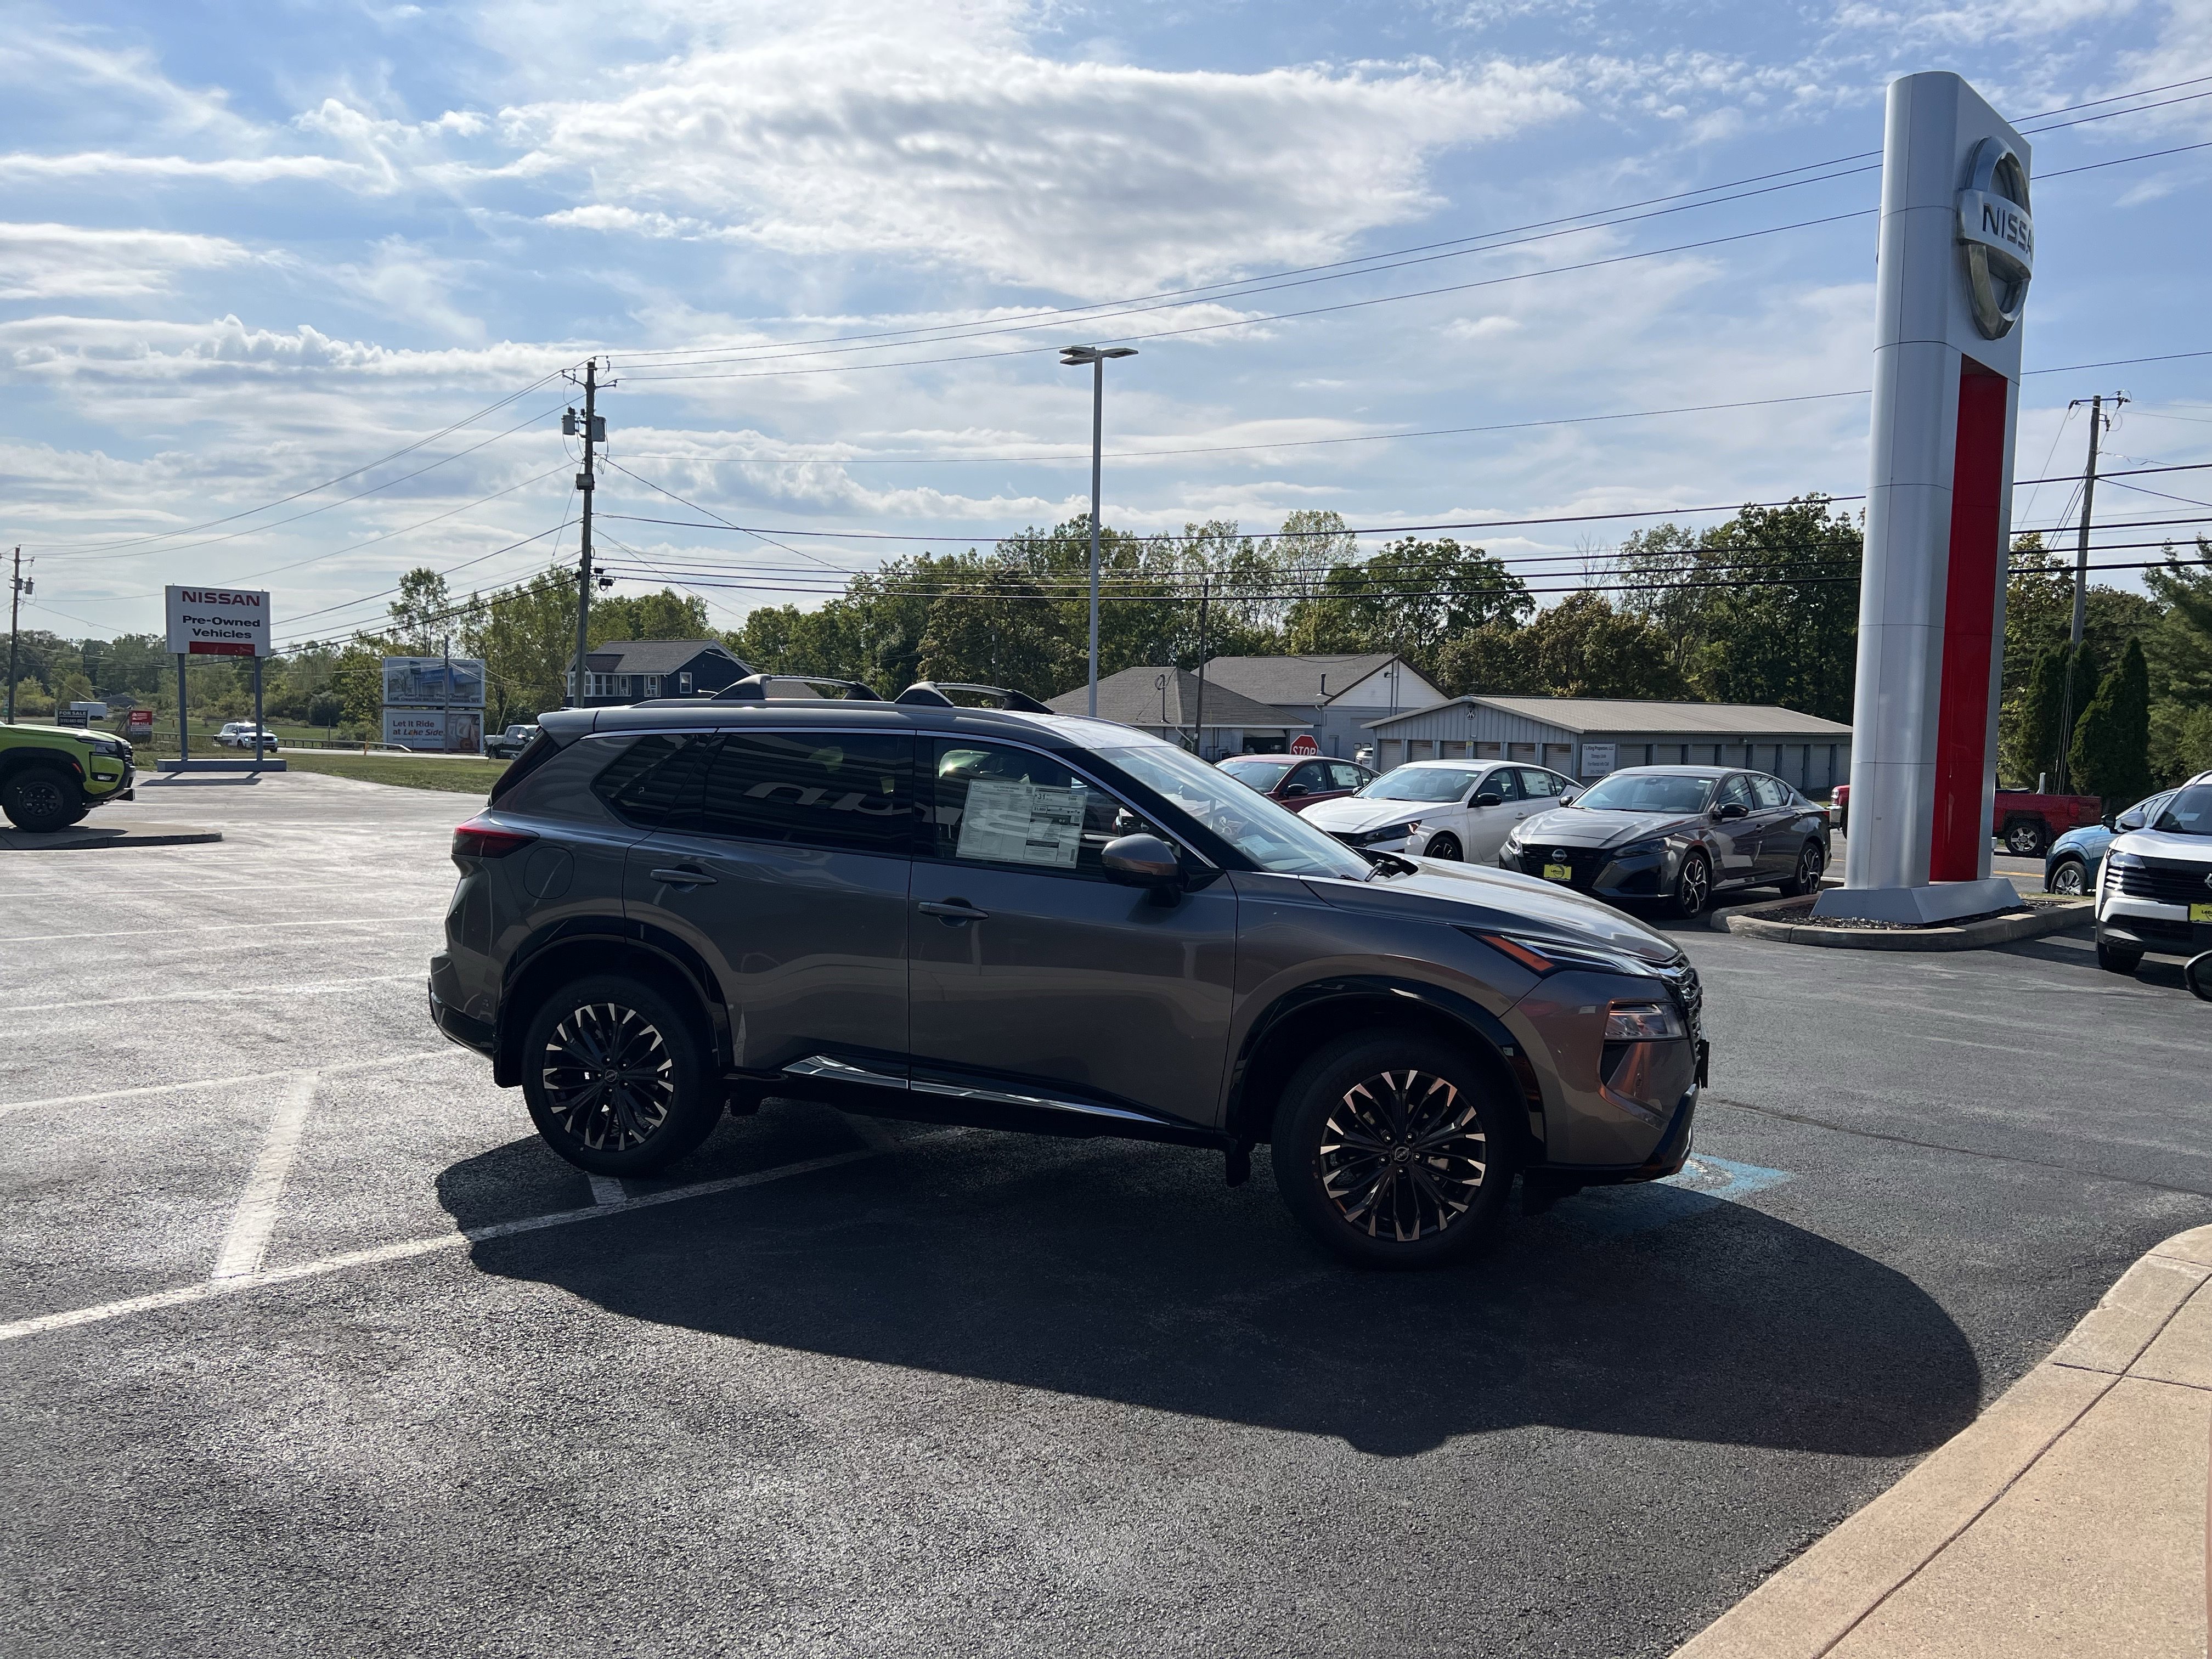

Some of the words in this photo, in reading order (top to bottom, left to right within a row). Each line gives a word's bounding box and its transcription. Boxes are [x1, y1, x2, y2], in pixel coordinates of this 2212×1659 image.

[1983, 202, 2034, 262] NISSA
[182, 591, 260, 606] NISSAN
[182, 615, 261, 627] Pre-Owned
[192, 628, 252, 639] Vehicles
[1293, 746, 1316, 755] STOP
